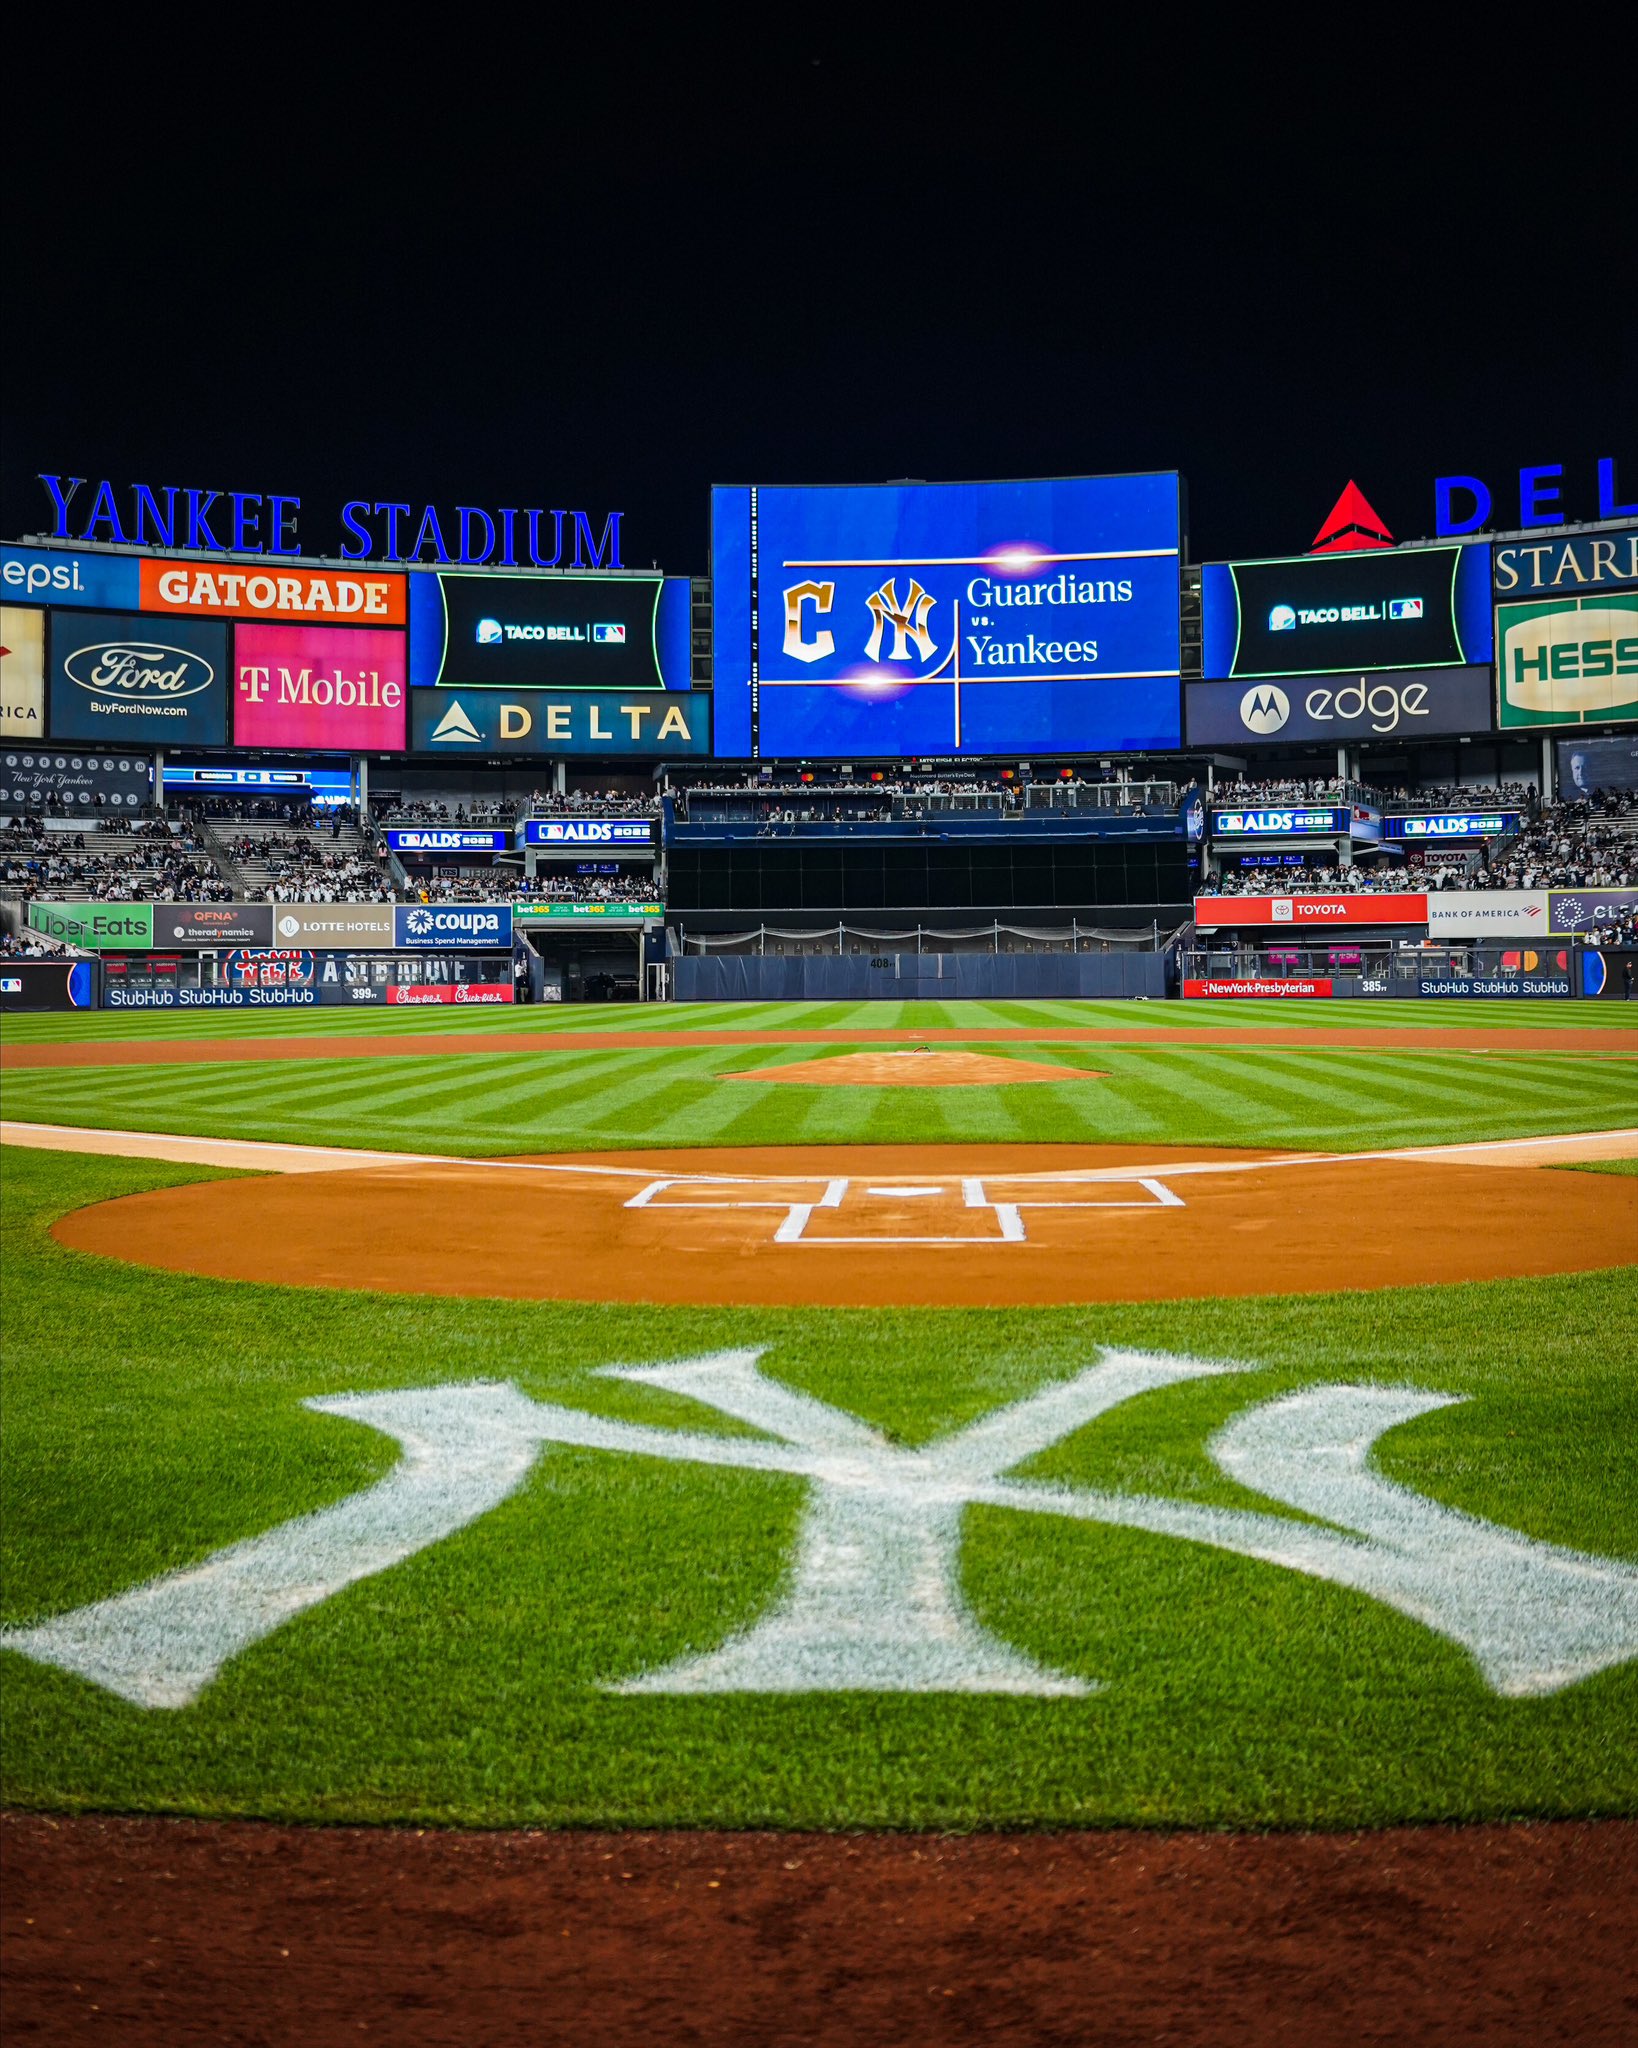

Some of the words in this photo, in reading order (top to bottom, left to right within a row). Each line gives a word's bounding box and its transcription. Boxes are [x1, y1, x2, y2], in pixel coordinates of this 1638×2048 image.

[1435, 457, 1638, 537] DEL
[38, 474, 301, 556] YANKEE
[340, 501, 624, 569] STADIUM
[0, 561, 79, 594] epsi
[158, 570, 389, 615] GATORADE
[967, 574, 1133, 607] Guardians
[971, 616, 995, 626] vs.
[1298, 608, 1340, 624] TACO
[1341, 605, 1381, 622] BELL
[504, 625, 545, 640] TACO
[547, 626, 585, 641] BELL
[966, 634, 1098, 665] Yankees
[1514, 638, 1638, 683] HESS
[91, 648, 188, 692] Ford
[280, 667, 401, 708] Mobile
[90, 702, 188, 717] BuyFordNow.com
[1305, 677, 1430, 733] edge
[500, 705, 692, 741] DELTA
[11, 771, 33, 783] New
[33, 773, 56, 788] York
[56, 774, 94, 788] Yankees
[1243, 813, 1294, 831] ALDS
[1295, 816, 1333, 825] 2022
[1426, 818, 1468, 834] ALDS
[1470, 821, 1503, 829] 2022
[419, 833, 461, 848] ALDS
[563, 824, 613, 841] ALDS
[613, 827, 650, 836] 2022
[1425, 853, 1468, 862] TOYOTA
[441, 868, 457, 876] YES
[467, 868, 515, 879] TERRACE
[194, 911, 233, 921] QFNA
[517, 905, 550, 913] bet365
[573, 905, 605, 913] bet365
[628, 905, 660, 913] bet365
[1297, 904, 1347, 915] TOYOTA
[1432, 911, 1458, 919] BANK
[1460, 910, 1473, 918] OF
[1475, 909, 1520, 918] AMERICA
[34, 915, 88, 936] Uber
[93, 916, 148, 936] Eats
[303, 922, 344, 931] LOTTE
[347, 921, 391, 931] HOTELS
[435, 913, 499, 935] coupa
[188, 928, 255, 938] theradynamics
[405, 937, 434, 945] Business
[434, 937, 455, 946] Spend
[456, 938, 499, 946] Management
[323, 955, 339, 982] A
[1209, 982, 1315, 996] NewYork-Presbyterian
[1421, 981, 1469, 994] StubHub
[1473, 981, 1519, 994] StubHub
[1522, 981, 1569, 993] StubHub
[110, 990, 173, 1006] StubHub
[178, 989, 243, 1004] StubHub
[249, 988, 314, 1003] StubHub
